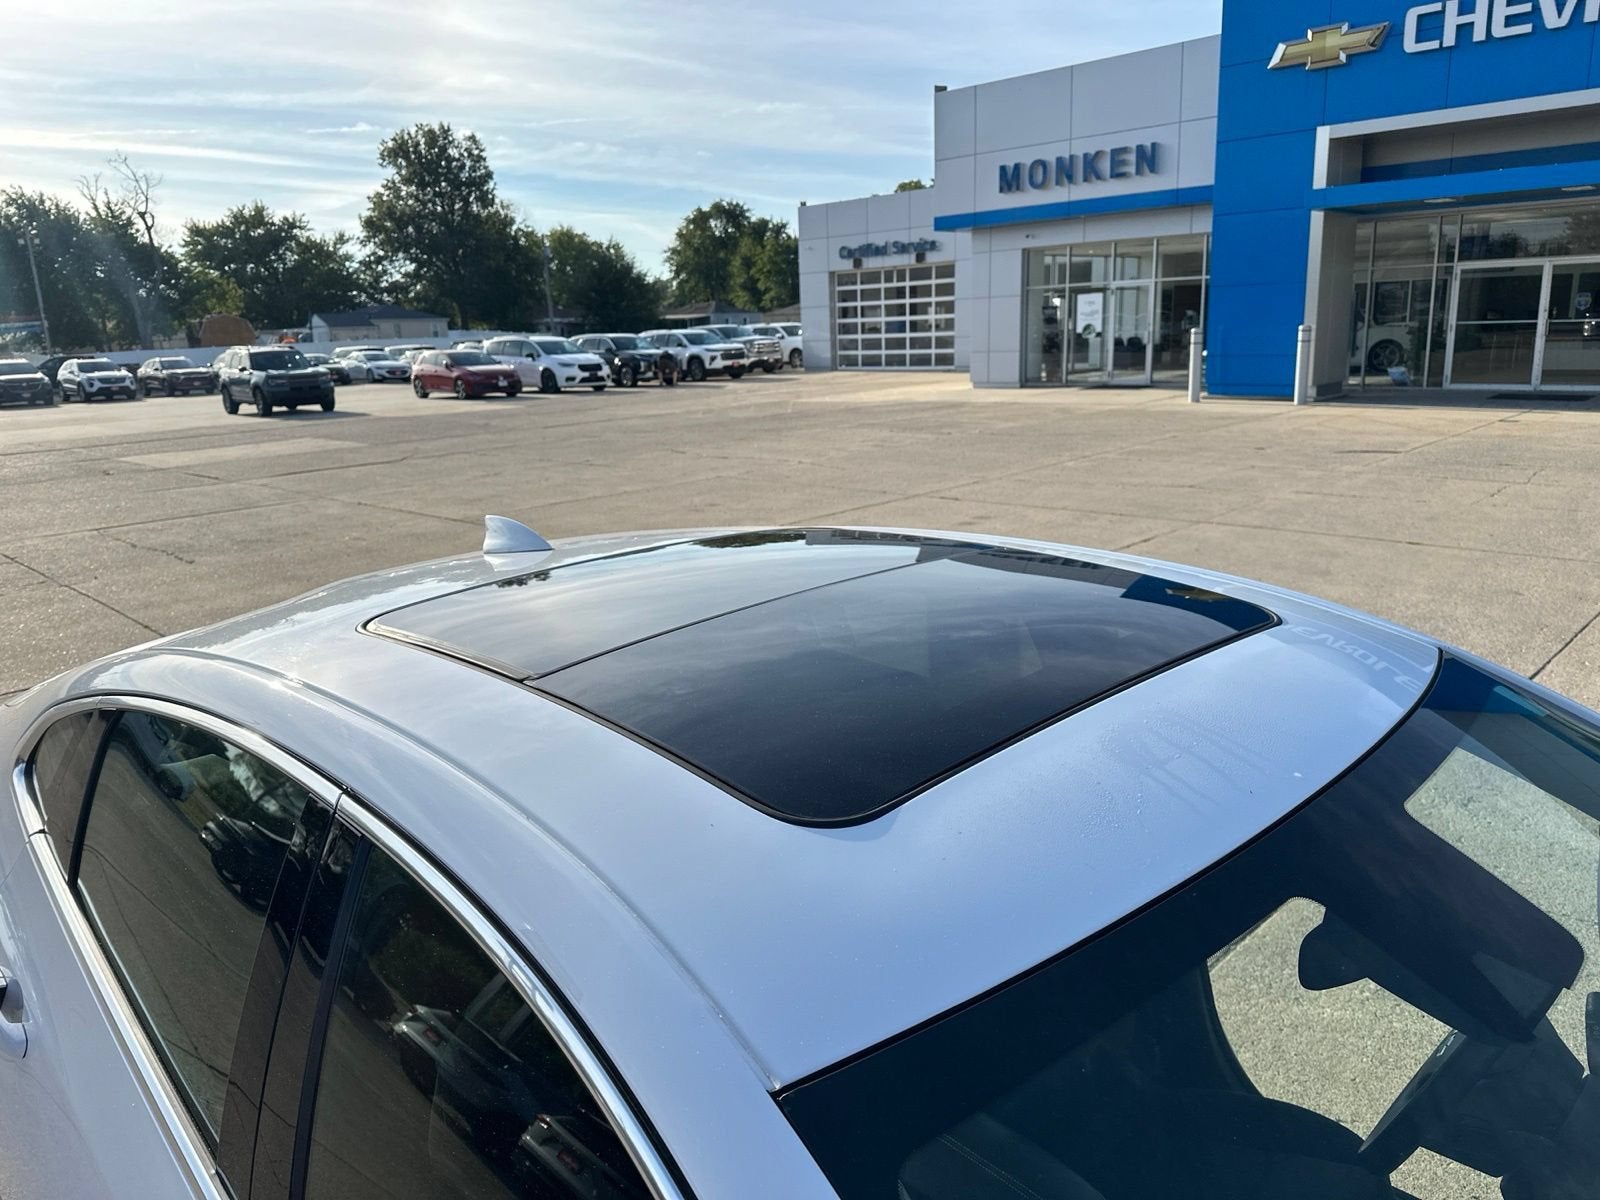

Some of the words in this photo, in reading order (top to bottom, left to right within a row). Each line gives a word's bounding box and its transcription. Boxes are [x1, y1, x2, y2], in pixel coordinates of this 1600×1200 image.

[999, 142, 1160, 193] MONKEN
[839, 240, 889, 259] Certified
[892, 238, 941, 255] Service
